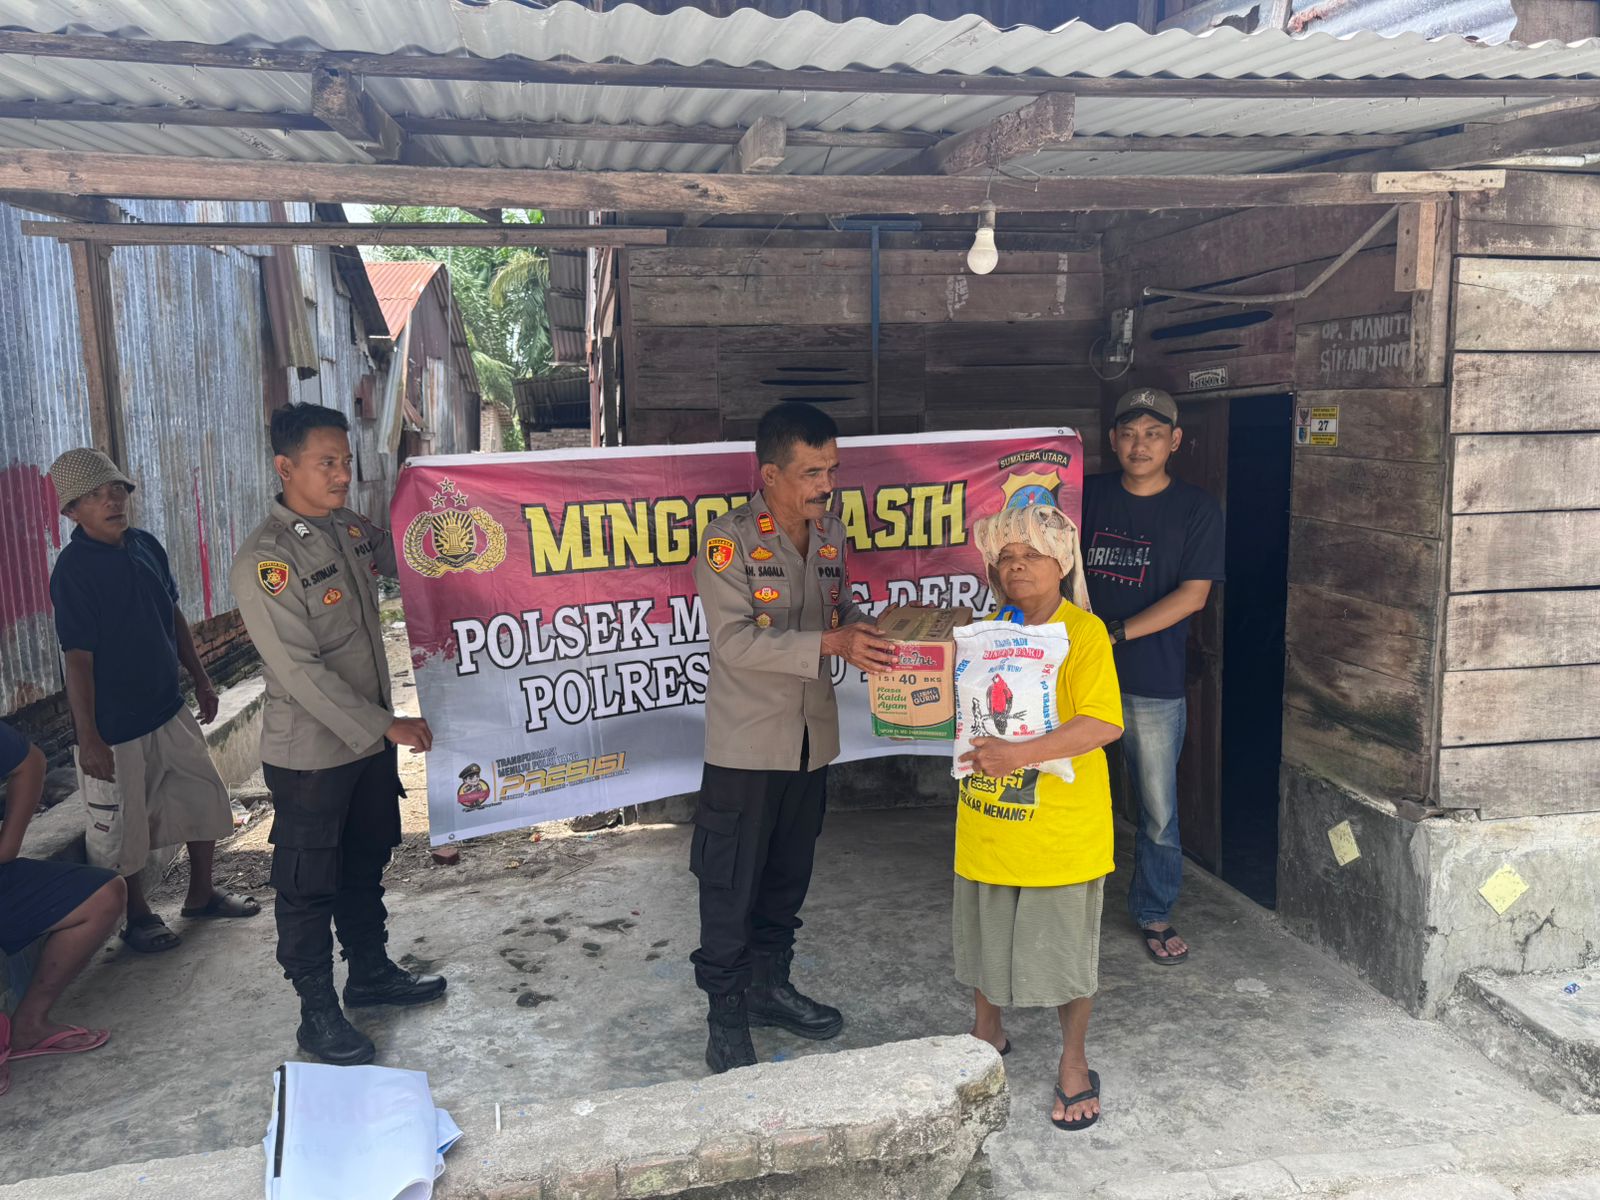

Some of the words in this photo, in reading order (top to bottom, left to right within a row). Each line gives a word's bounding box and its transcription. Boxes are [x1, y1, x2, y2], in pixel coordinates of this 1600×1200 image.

[1318, 420, 1329, 431] 27
[1000, 452, 1041, 468] SUMATERA
[1042, 452, 1067, 465] UTARA
[521, 491, 752, 577] MINGG
[826, 480, 968, 553] ASIH
[1087, 546, 1150, 567] ORIGINAL
[758, 567, 785, 578] SAGALA
[452, 598, 658, 676] POLSEK
[899, 674, 917, 686] 40
[521, 653, 712, 731] POLRES
[878, 693, 907, 702] Kaldu
[878, 701, 908, 711] Ayam
[500, 751, 627, 796] PRESISI
[970, 780, 997, 794] 2024
[984, 803, 1026, 822] MENANG
